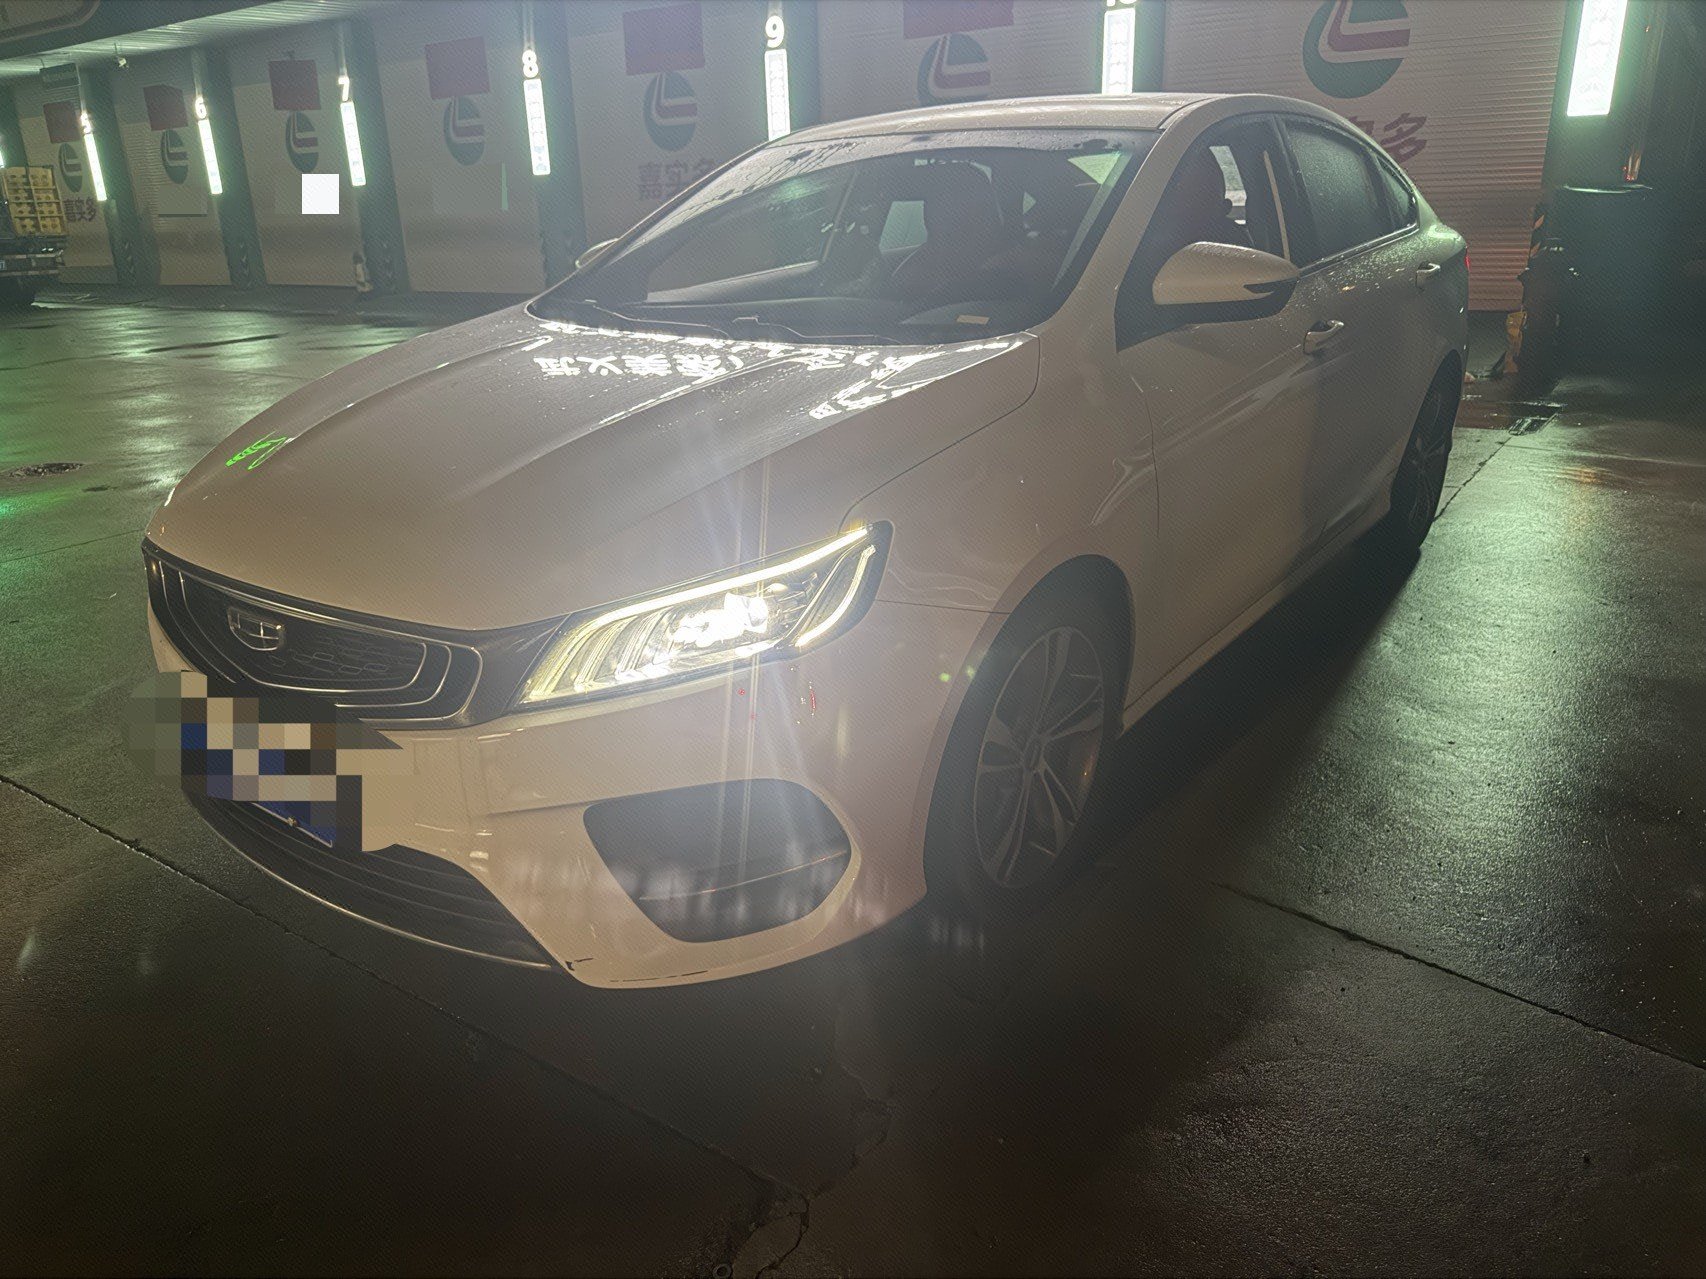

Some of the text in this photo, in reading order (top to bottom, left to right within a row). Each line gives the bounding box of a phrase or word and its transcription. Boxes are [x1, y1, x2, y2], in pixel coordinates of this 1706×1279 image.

[765, 15, 785, 48] 9
[522, 49, 539, 78] 8
[338, 75, 350, 102] 7
[195, 96, 207, 119] 6
